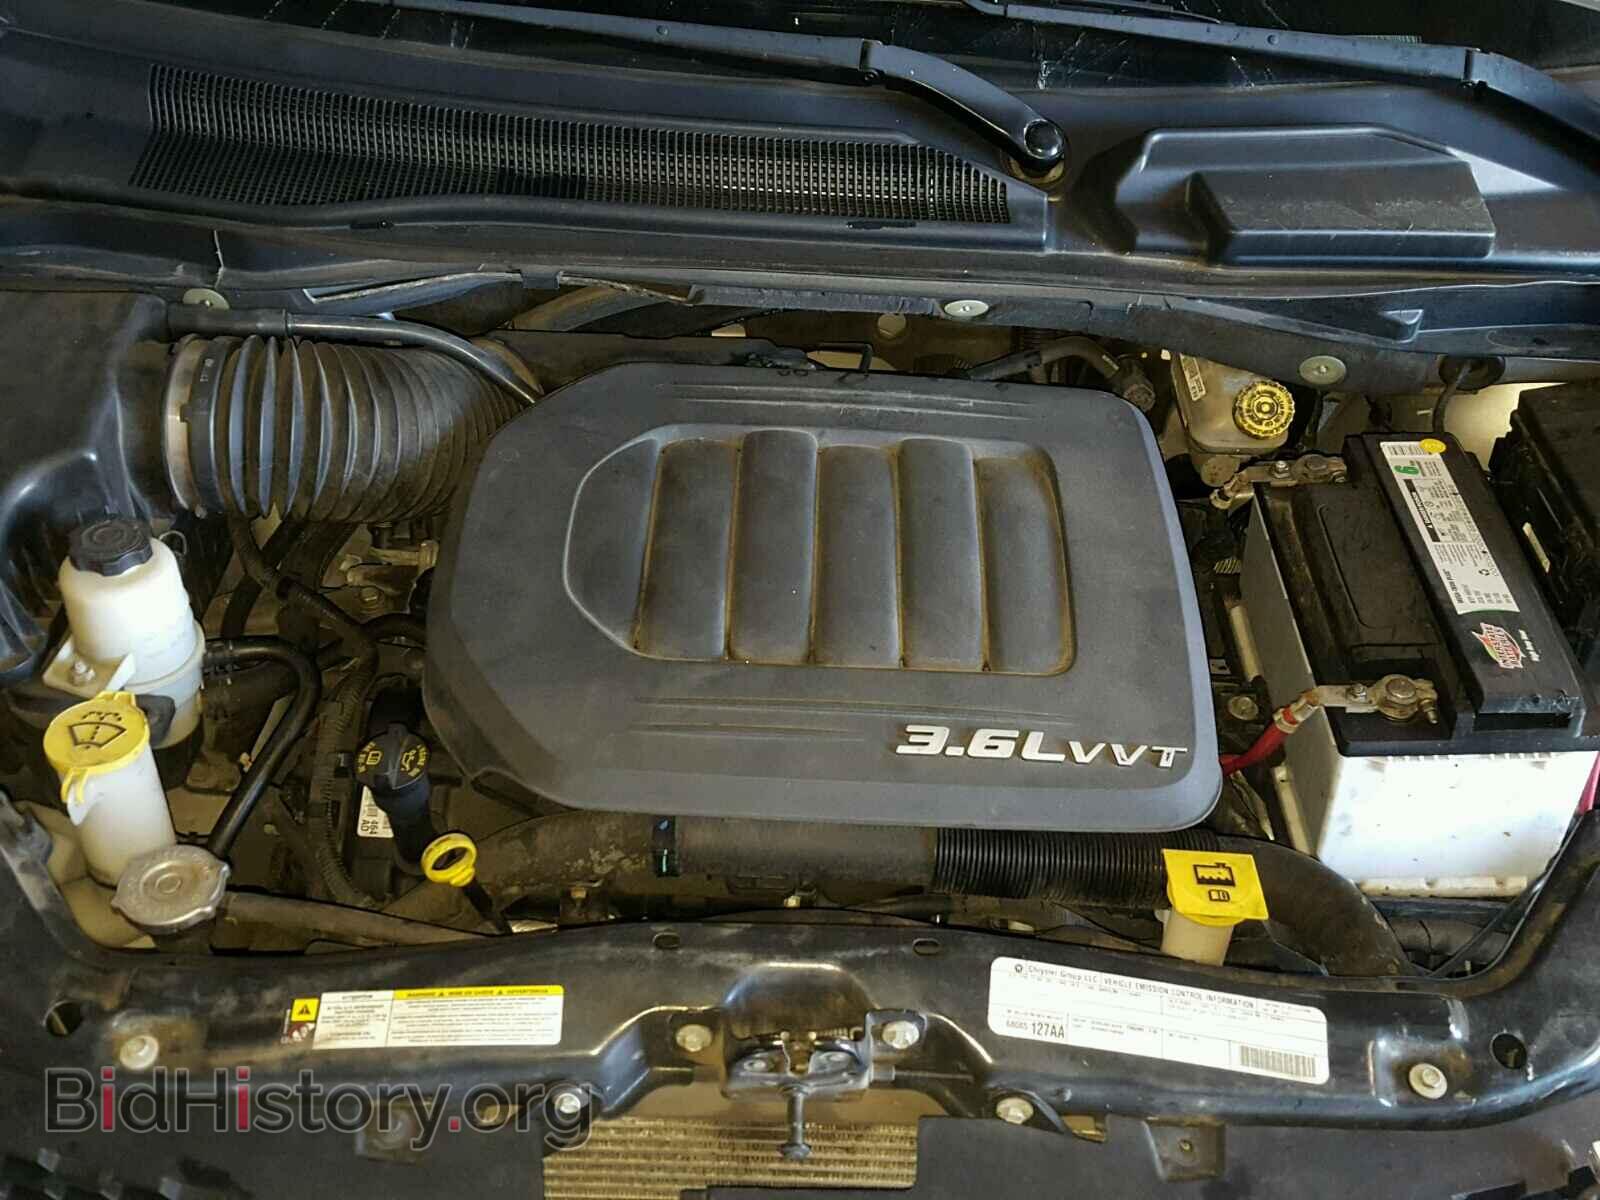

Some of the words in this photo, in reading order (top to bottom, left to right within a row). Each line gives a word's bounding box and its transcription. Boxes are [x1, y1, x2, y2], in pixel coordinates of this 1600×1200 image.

[1027, 964, 1059, 976] Chrysler
[1059, 969, 1082, 981] Group
[1103, 977, 1133, 989] VEHICLE
[1134, 982, 1169, 995] EMISSION
[1171, 987, 1203, 1001] CONTROL
[1205, 993, 1255, 1009] INFORMATION
[1031, 1022, 1065, 1039] 127AA
